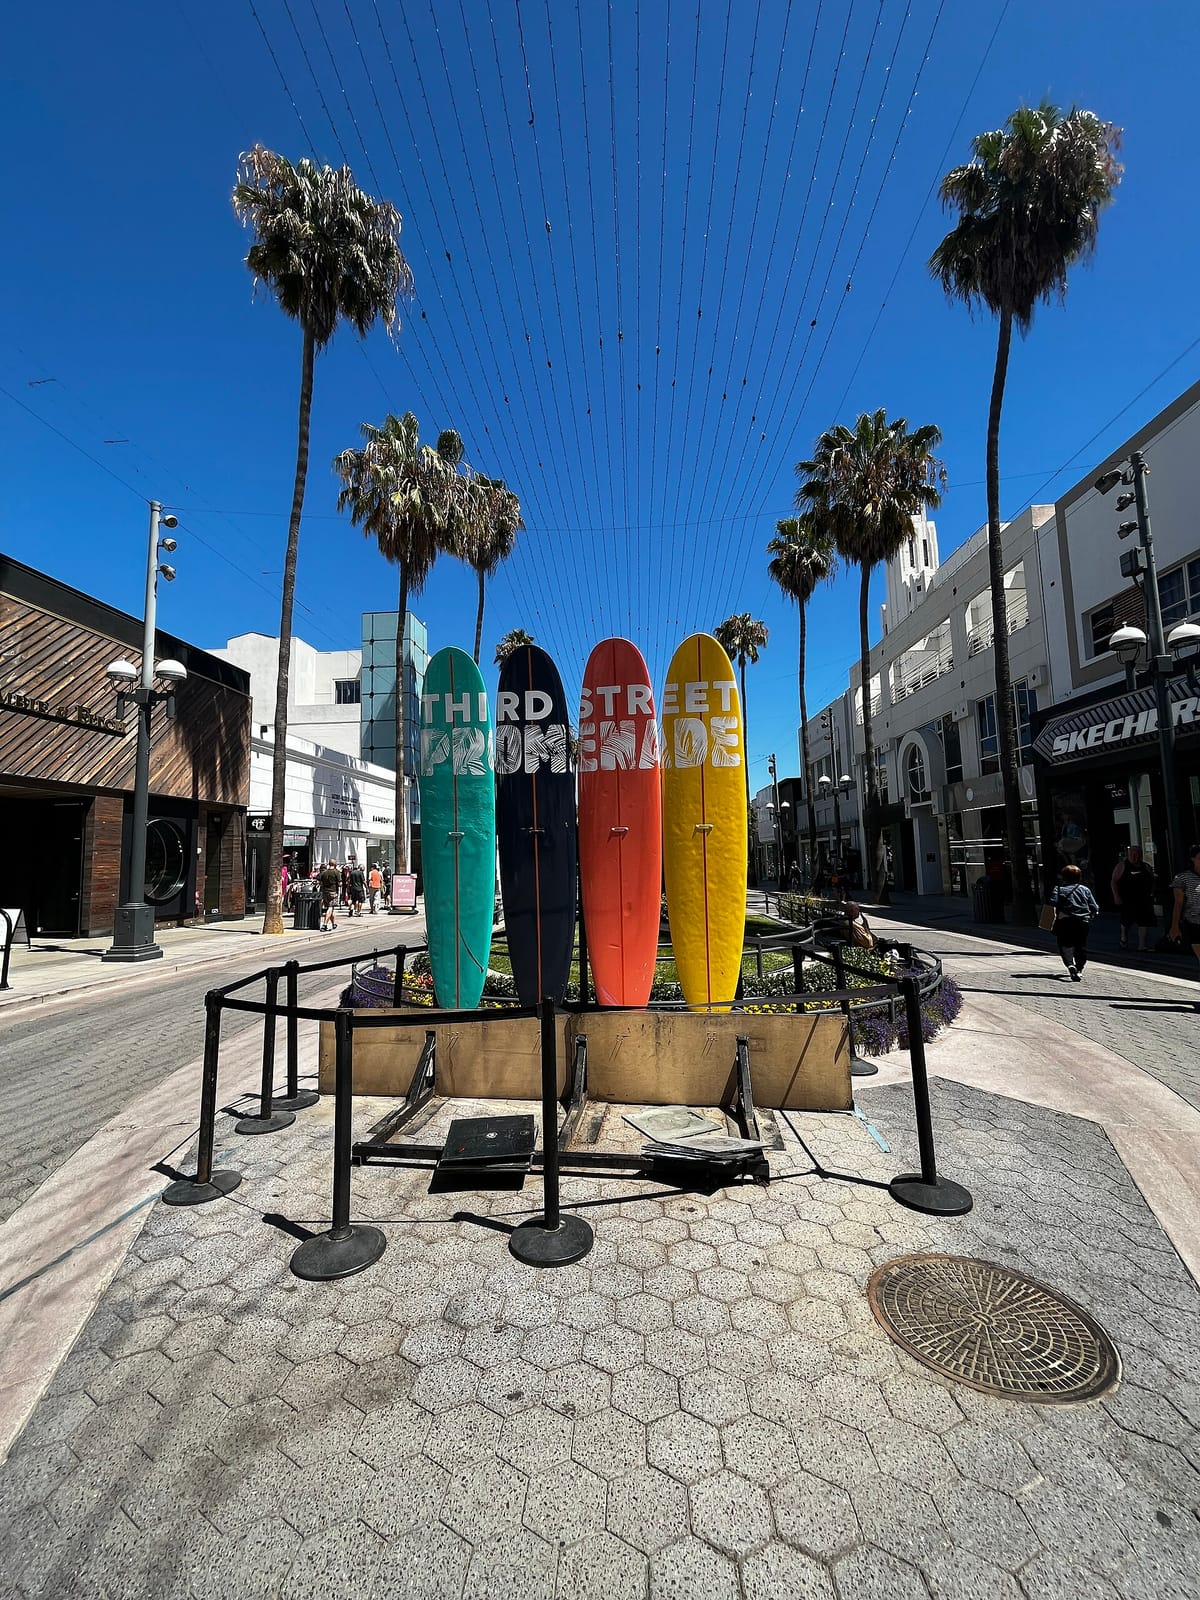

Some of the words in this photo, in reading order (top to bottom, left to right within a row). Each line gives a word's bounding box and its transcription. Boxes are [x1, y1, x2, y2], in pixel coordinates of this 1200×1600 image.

[421, 690, 554, 723] THIRD
[579, 680, 737, 718] STREET
[1052, 696, 1200, 757] SKECHR
[420, 717, 742, 776] PROMENADE
